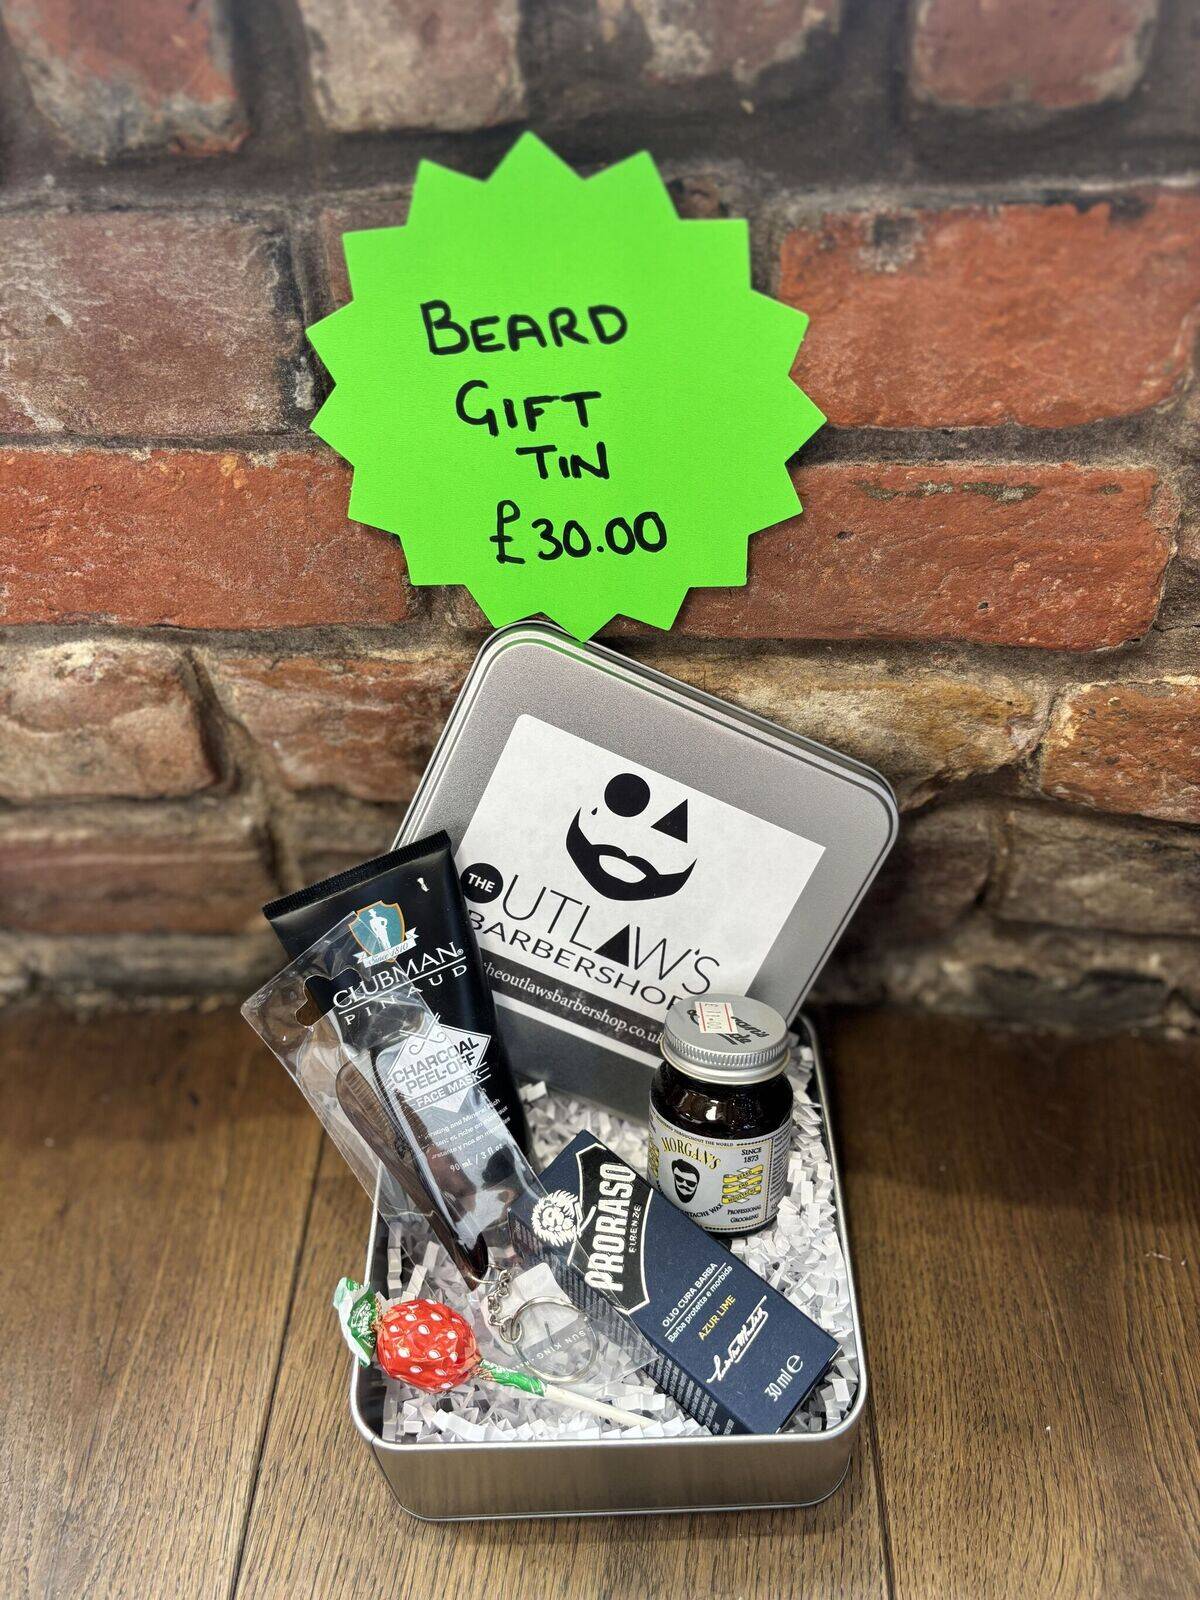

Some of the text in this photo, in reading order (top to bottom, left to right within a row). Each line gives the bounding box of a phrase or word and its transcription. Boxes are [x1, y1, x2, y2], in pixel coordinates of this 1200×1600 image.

[421, 300, 628, 355] BEARD
[456, 380, 602, 436] GIFT
[516, 442, 610, 480] TIN
[490, 500, 668, 564] £30.00
[469, 873, 495, 893] THE
[344, 964, 467, 1026] PINAUD
[392, 1037, 479, 1084] CHARCOAL
[405, 1051, 475, 1094] PEEL-OFF
[416, 1087, 445, 1108] FACE
[447, 1071, 482, 1093] MASK
[450, 1162, 461, 1172] 90
[661, 1137, 722, 1170] MORGAN'S
[741, 1147, 762, 1156] SINCE
[744, 1155, 759, 1163] 1873
[584, 1162, 637, 1292] PRORASO
[628, 1204, 642, 1254] FIRENZE
[662, 1262, 718, 1327] OLIO CURA BARBA
[667, 1322, 687, 1343] Barba
[684, 1295, 708, 1325] protetta
[710, 1265, 733, 1294] morbida
[698, 1294, 736, 1341] AZUR LIME
[536, 1330, 586, 1360] SUN KING
[764, 1382, 782, 1402] 30
[776, 1368, 793, 1389] ml
